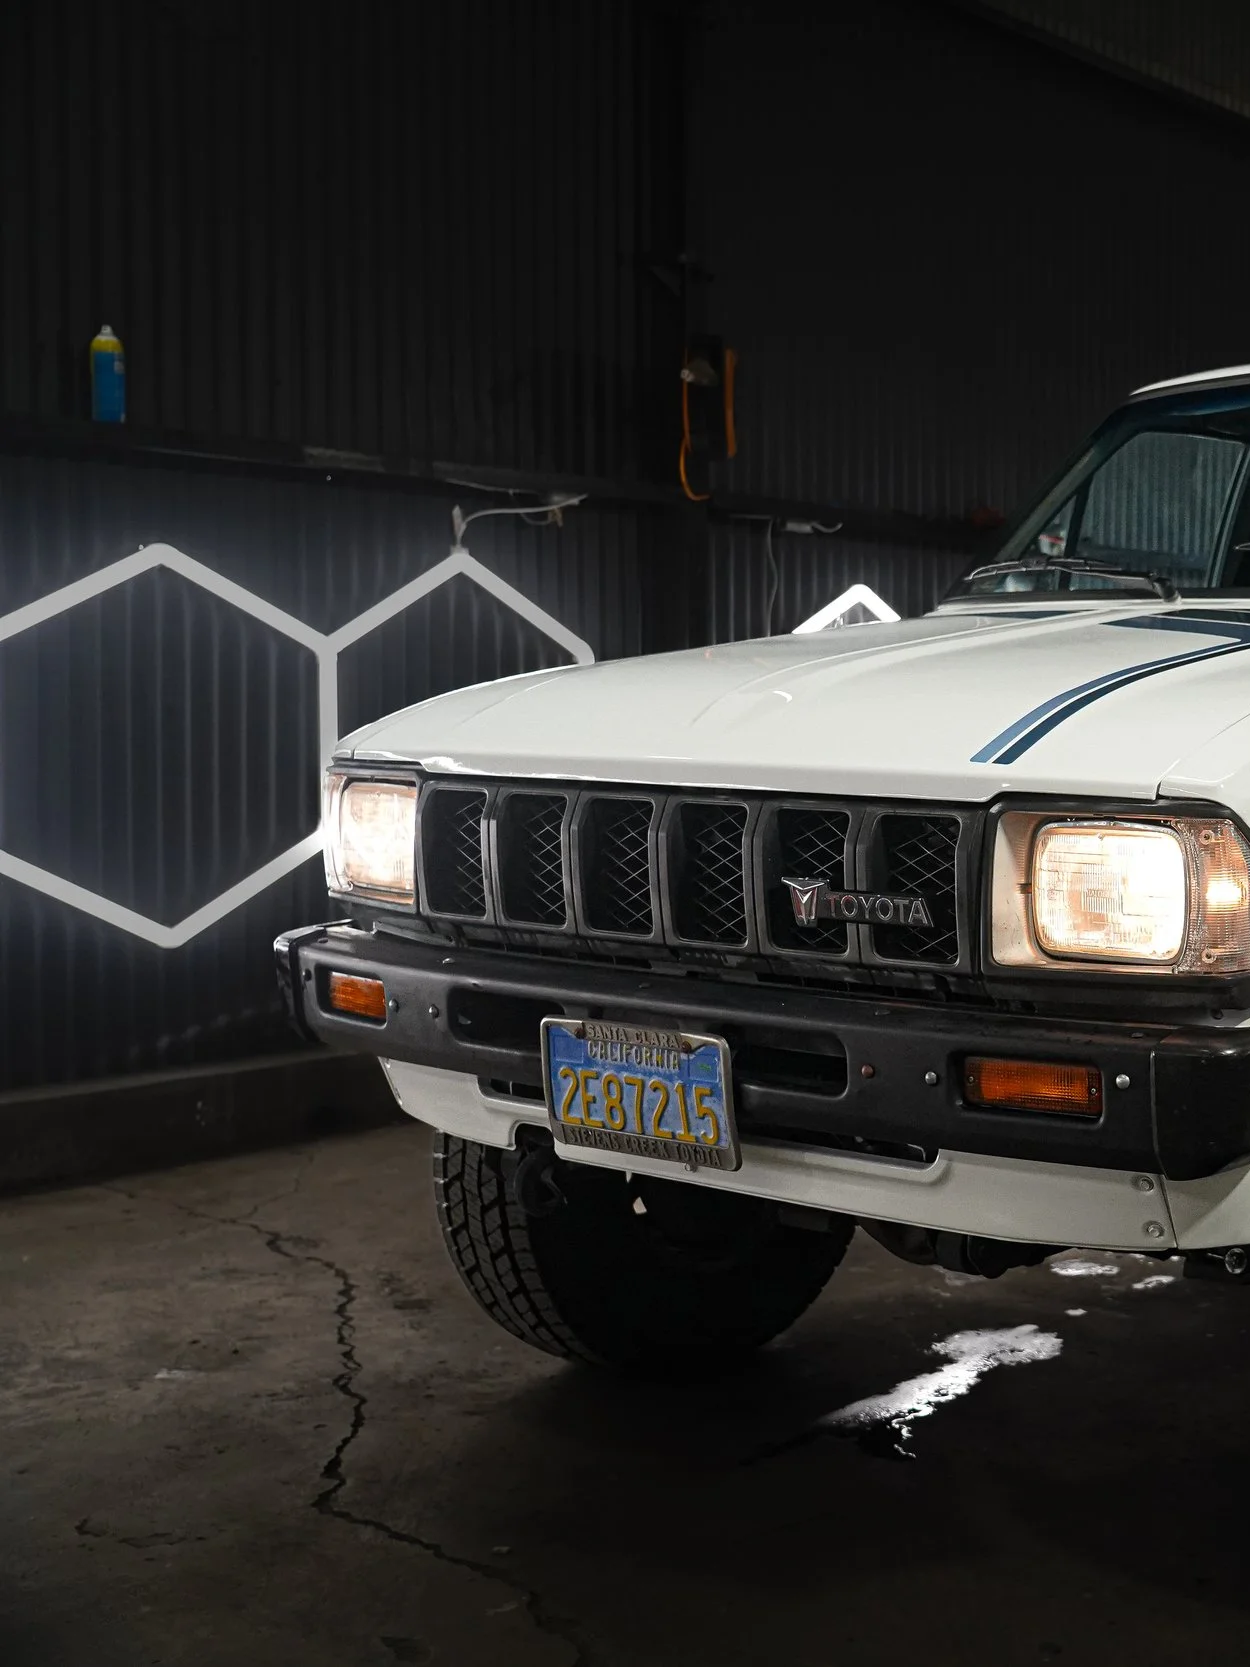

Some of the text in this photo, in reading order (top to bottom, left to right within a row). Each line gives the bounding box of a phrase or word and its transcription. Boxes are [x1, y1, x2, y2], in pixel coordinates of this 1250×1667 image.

[825, 893, 930, 925] TOYOTA
[587, 1023, 680, 1049] SANTA CLARA
[587, 1040, 681, 1070] CALIFORNIA
[559, 1066, 720, 1146] 2E87215
[569, 1127, 721, 1166] STEVENS CREEK TOYOTA
